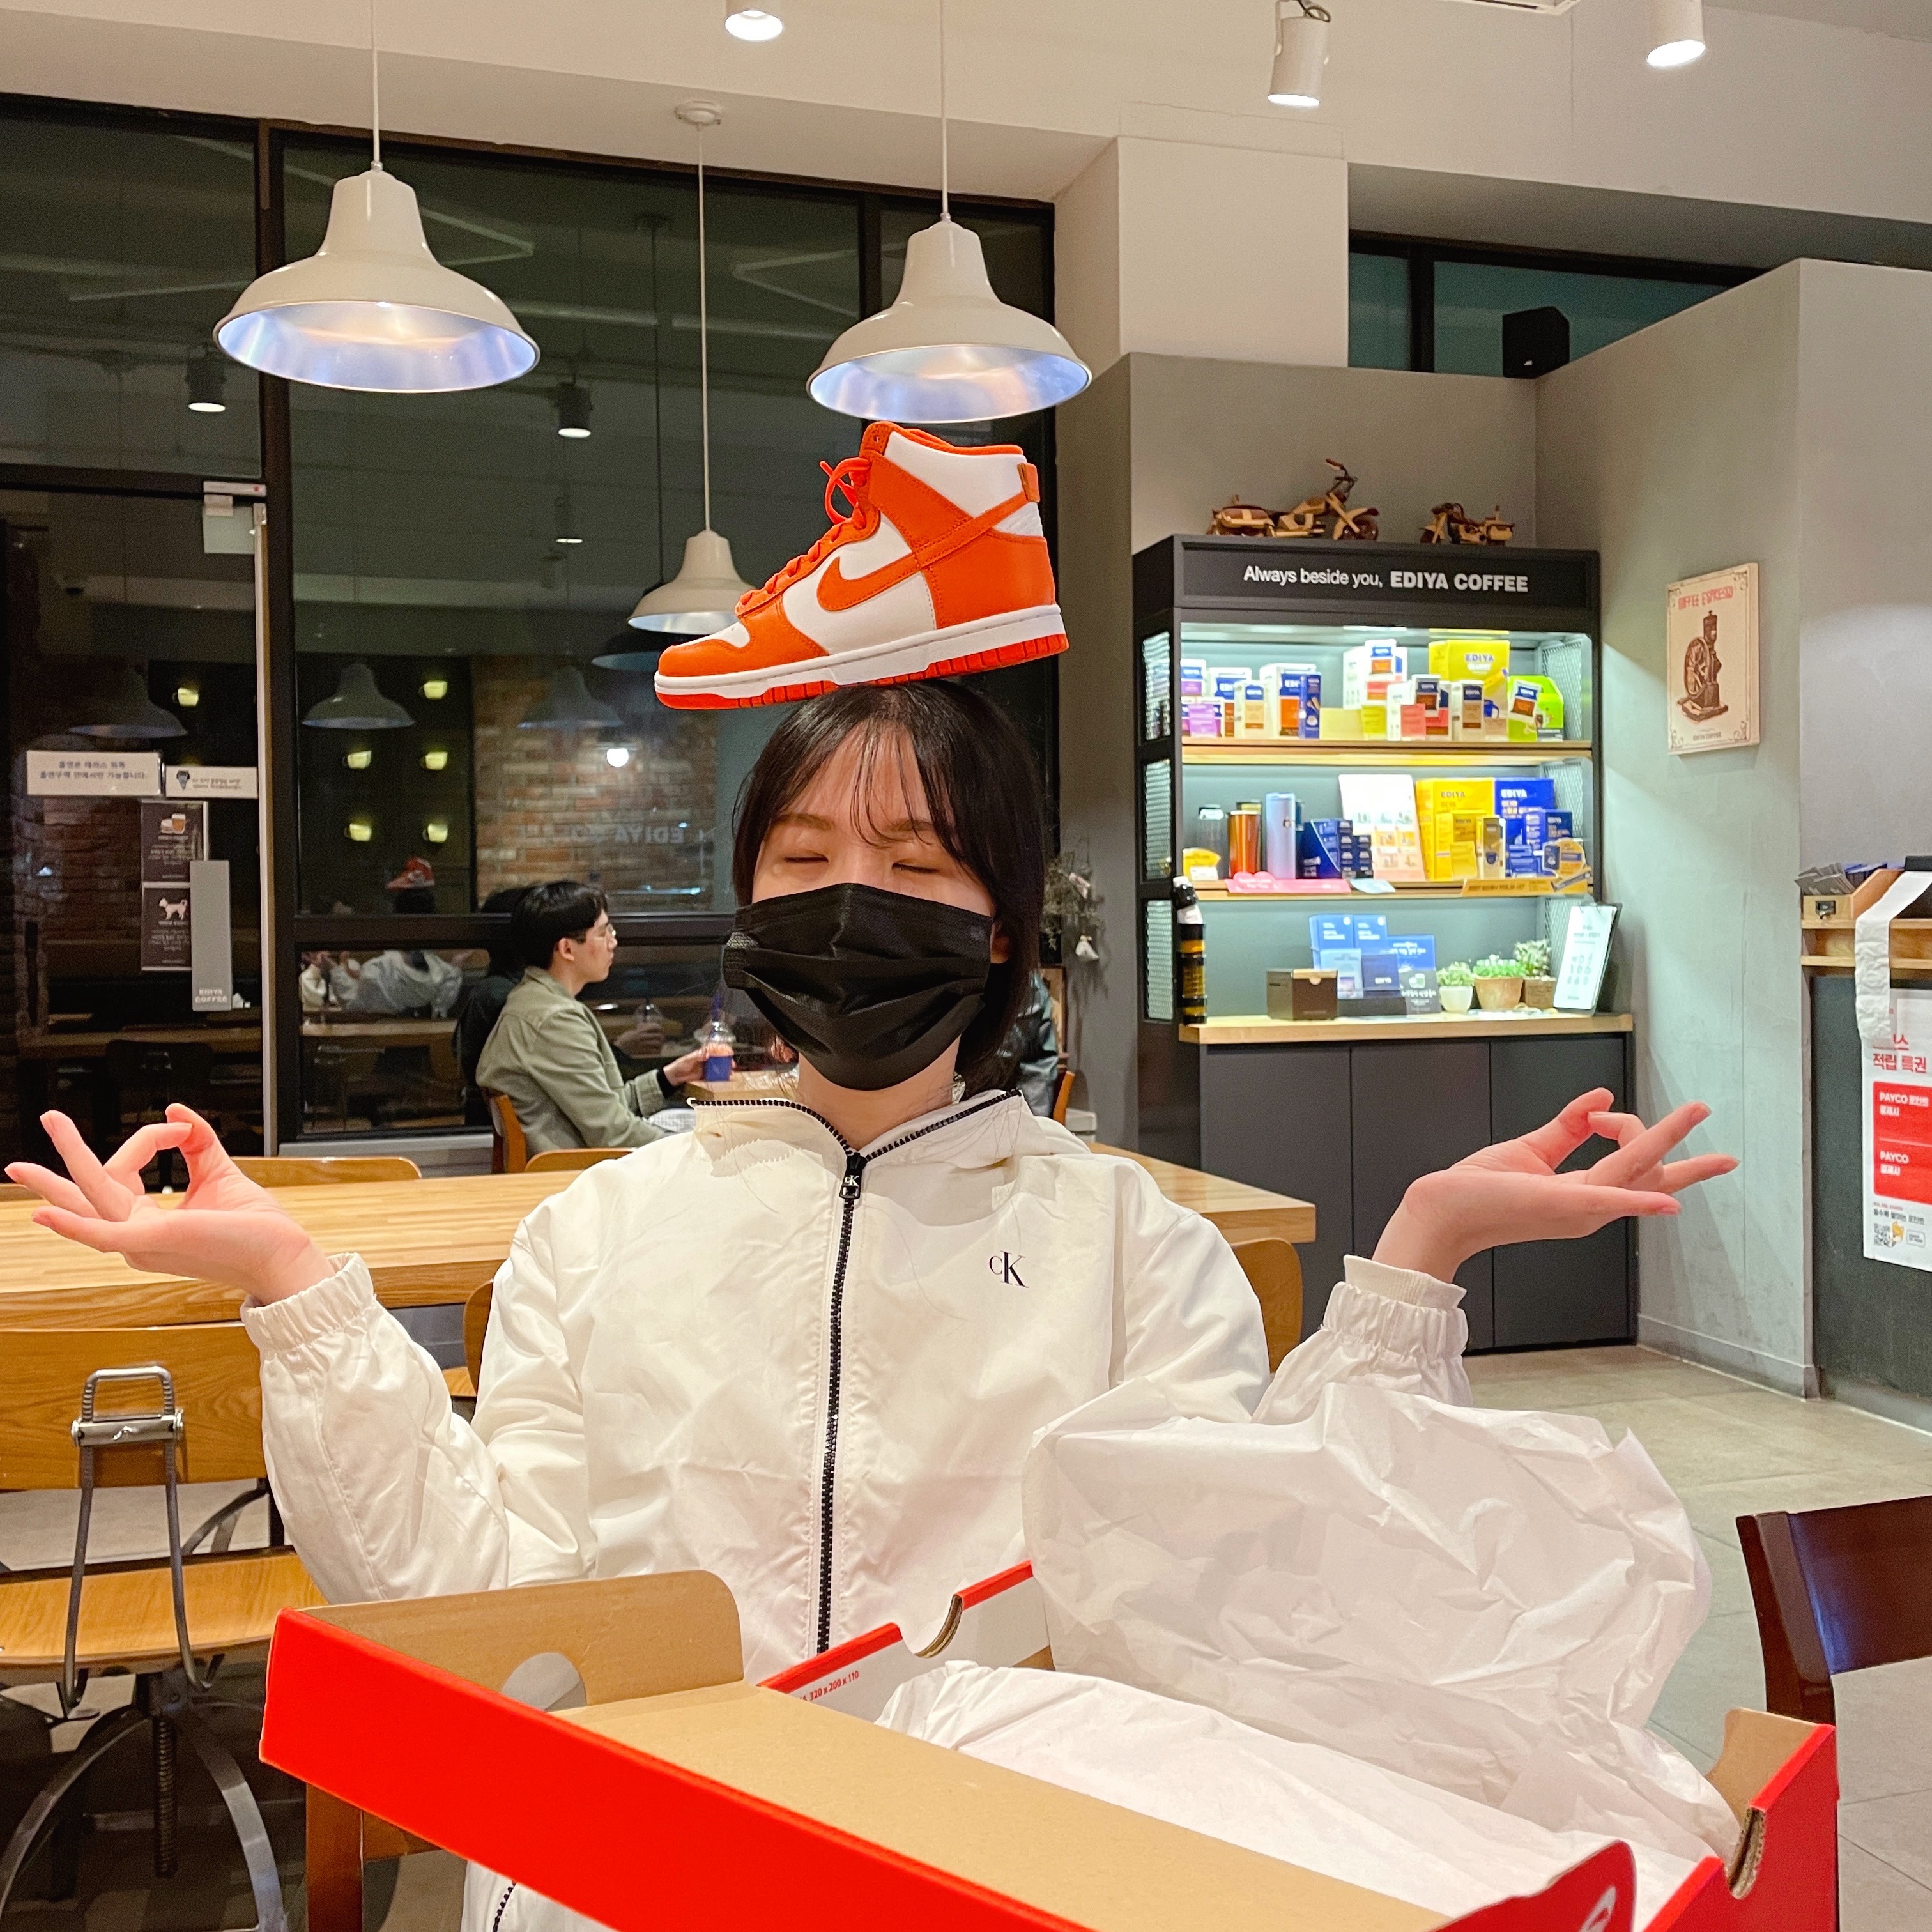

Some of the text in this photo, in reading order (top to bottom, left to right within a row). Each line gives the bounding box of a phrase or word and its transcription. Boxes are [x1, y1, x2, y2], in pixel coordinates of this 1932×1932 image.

[1243, 565, 1529, 593] Always beside you, EDIYA COFFEE
[1465, 654, 1494, 662] EDIYA
[1501, 788, 1528, 799] EDIYA
[1873, 1053, 1927, 1074] 적립 특권
[1879, 1091, 1908, 1105] PAYCO
[1880, 1150, 1910, 1164] PAYCO
[809, 1687, 822, 1701] 320
[823, 1686, 828, 1695] x
[829, 1678, 841, 1692] 200
[842, 1677, 847, 1686] x
[848, 1670, 859, 1682] 110
